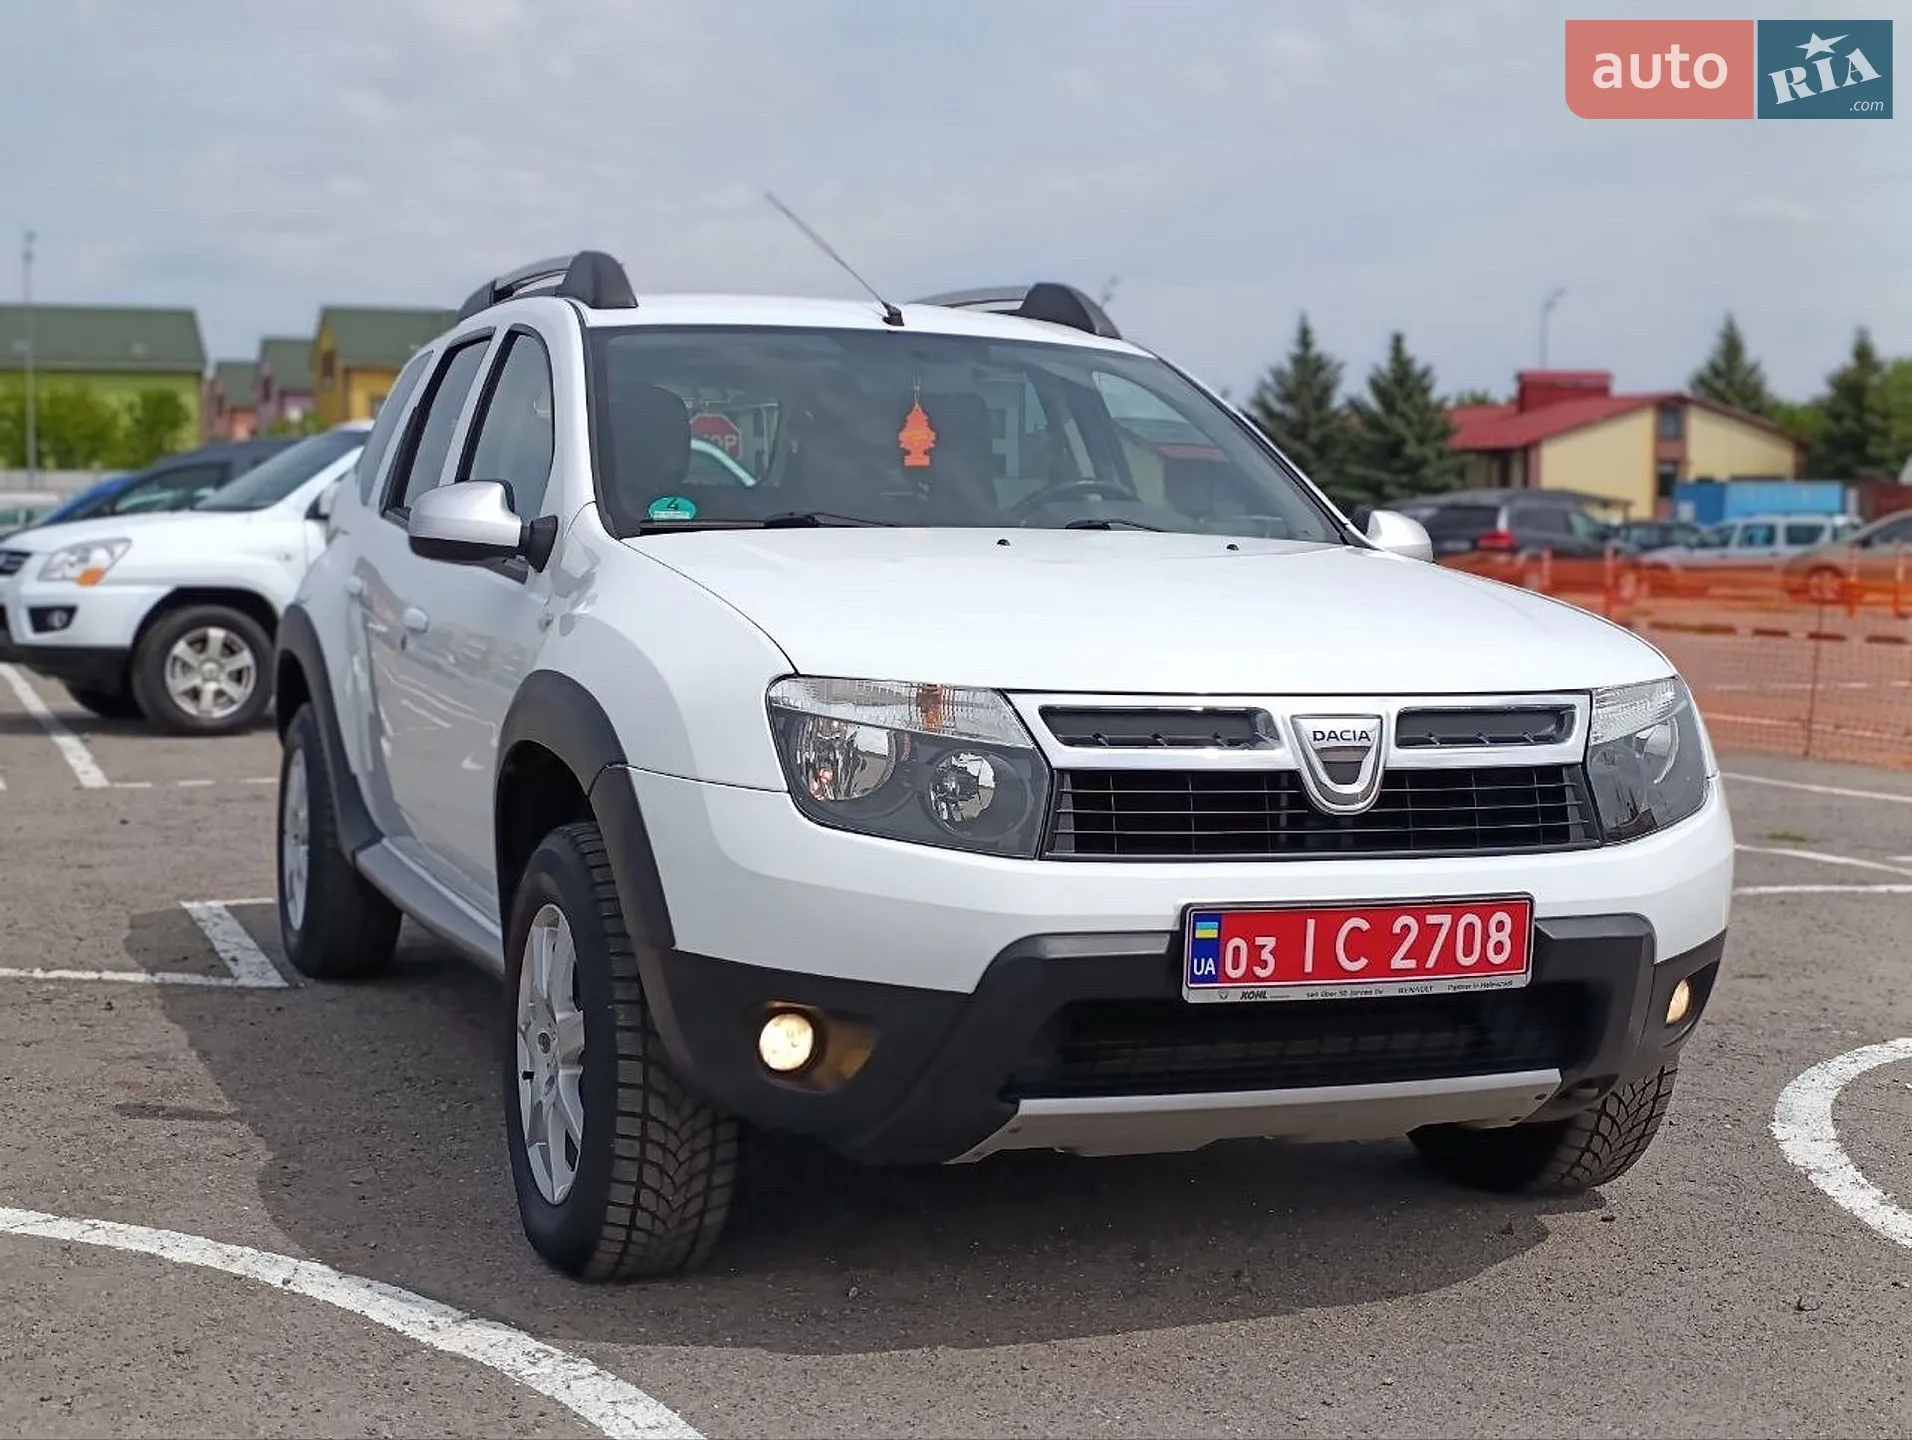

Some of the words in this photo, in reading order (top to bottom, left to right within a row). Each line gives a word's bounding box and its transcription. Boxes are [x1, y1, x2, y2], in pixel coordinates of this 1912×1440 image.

[666, 498, 680, 511] 4
[1312, 730, 1371, 742] DACIA
[1225, 936, 1277, 979] 03
[1390, 911, 1512, 970] 2708
[1193, 957, 1216, 976] UA
